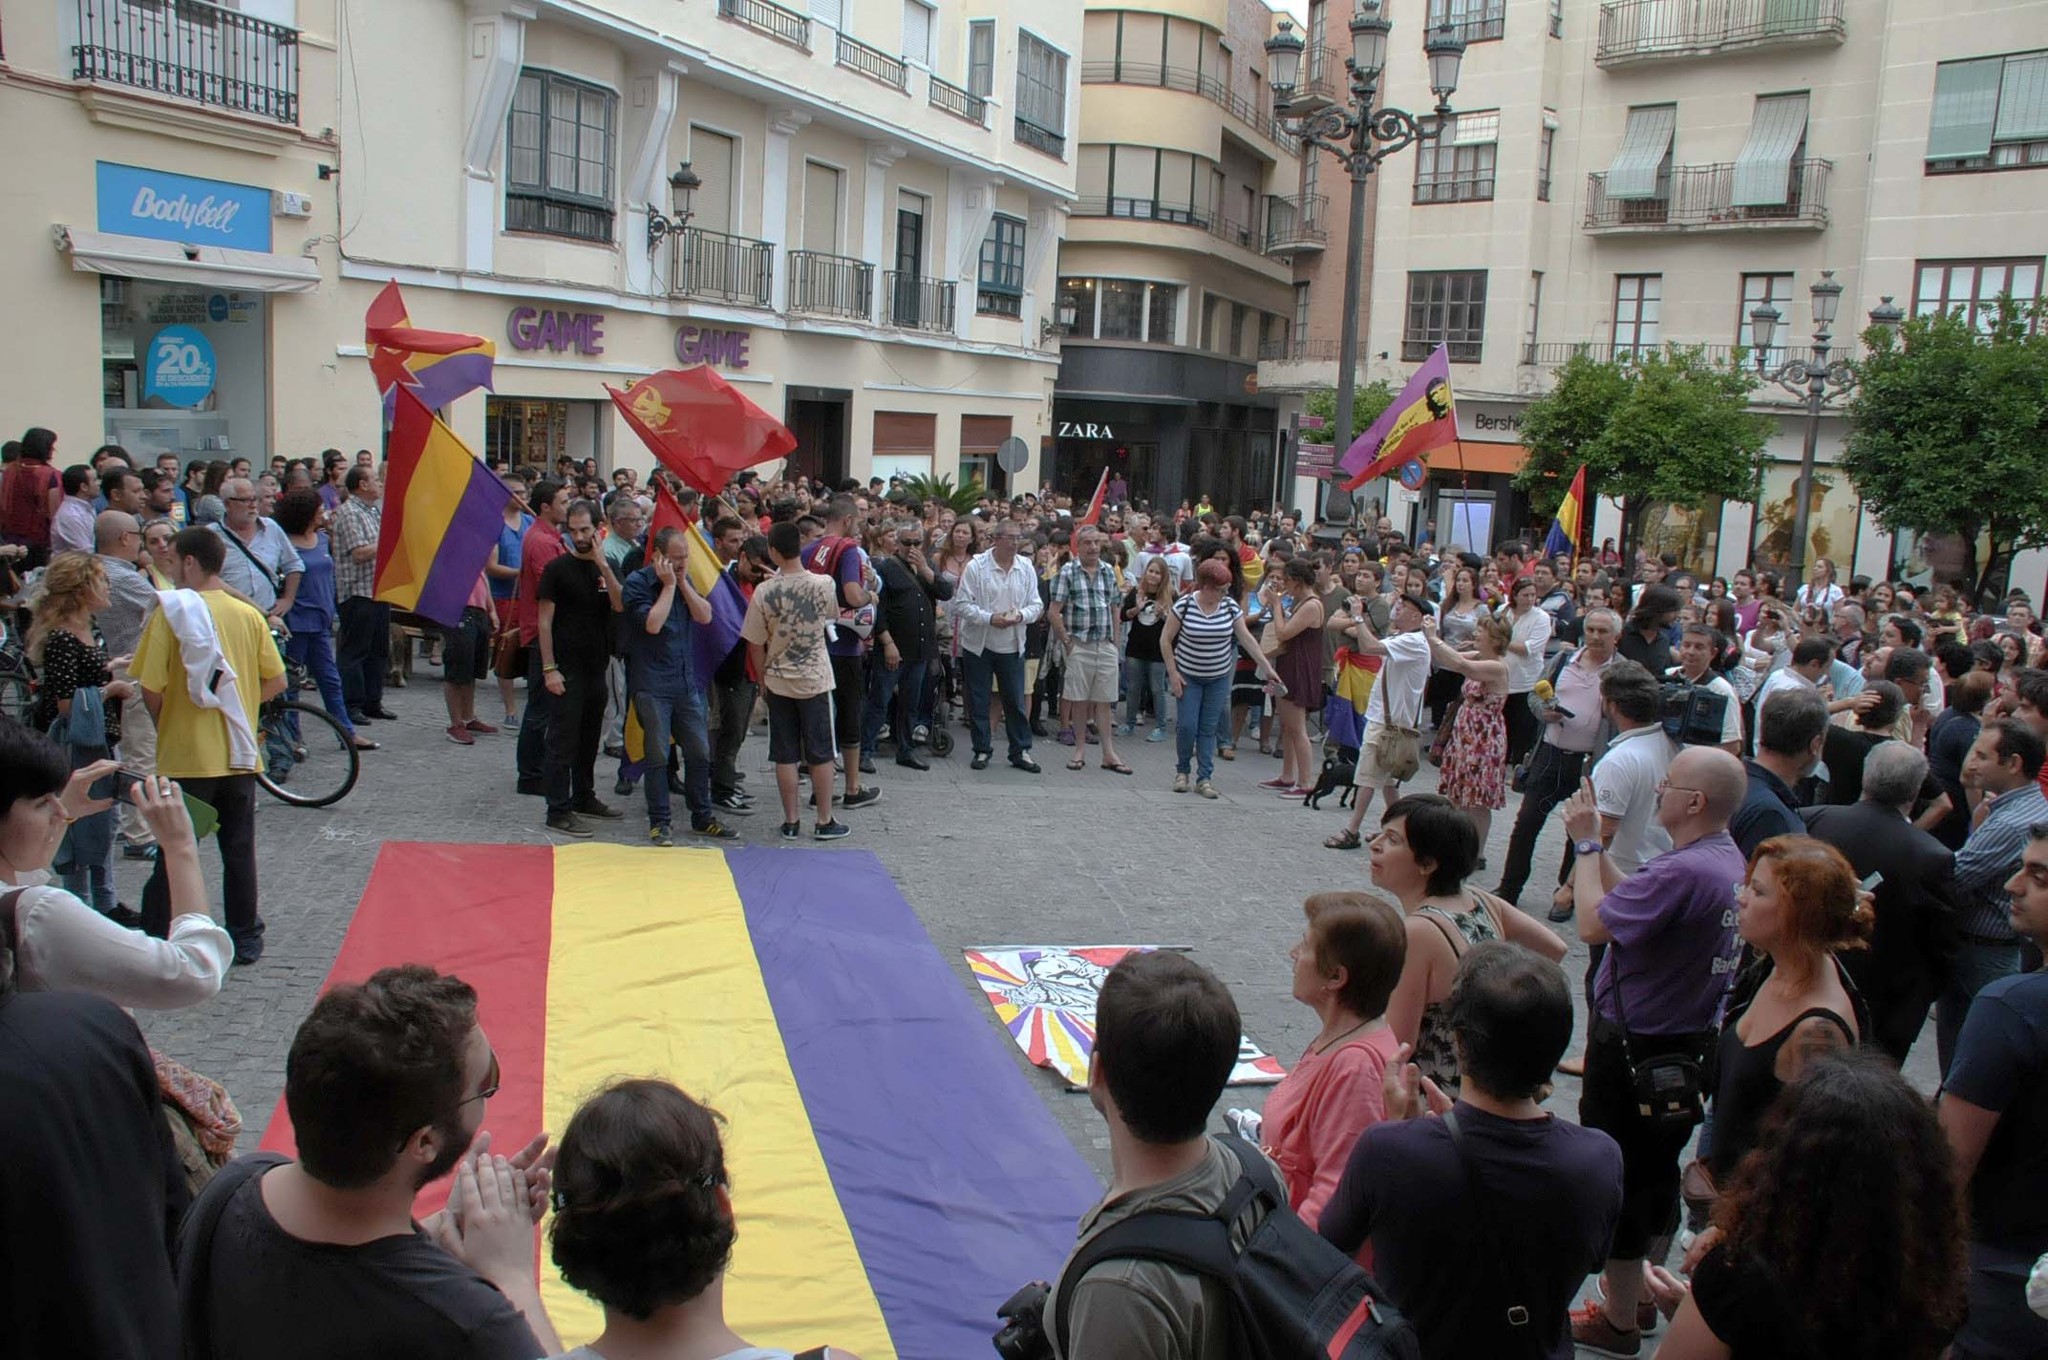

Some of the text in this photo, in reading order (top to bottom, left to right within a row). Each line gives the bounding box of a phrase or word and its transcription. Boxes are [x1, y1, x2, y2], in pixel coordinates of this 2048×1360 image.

[132, 187, 240, 233] Bodybell
[507, 306, 605, 356] GAME
[674, 326, 750, 369] GAME
[156, 344, 212, 375] 20%
[1058, 421, 1114, 439] ZARA
[1475, 413, 1525, 431] Bershk
